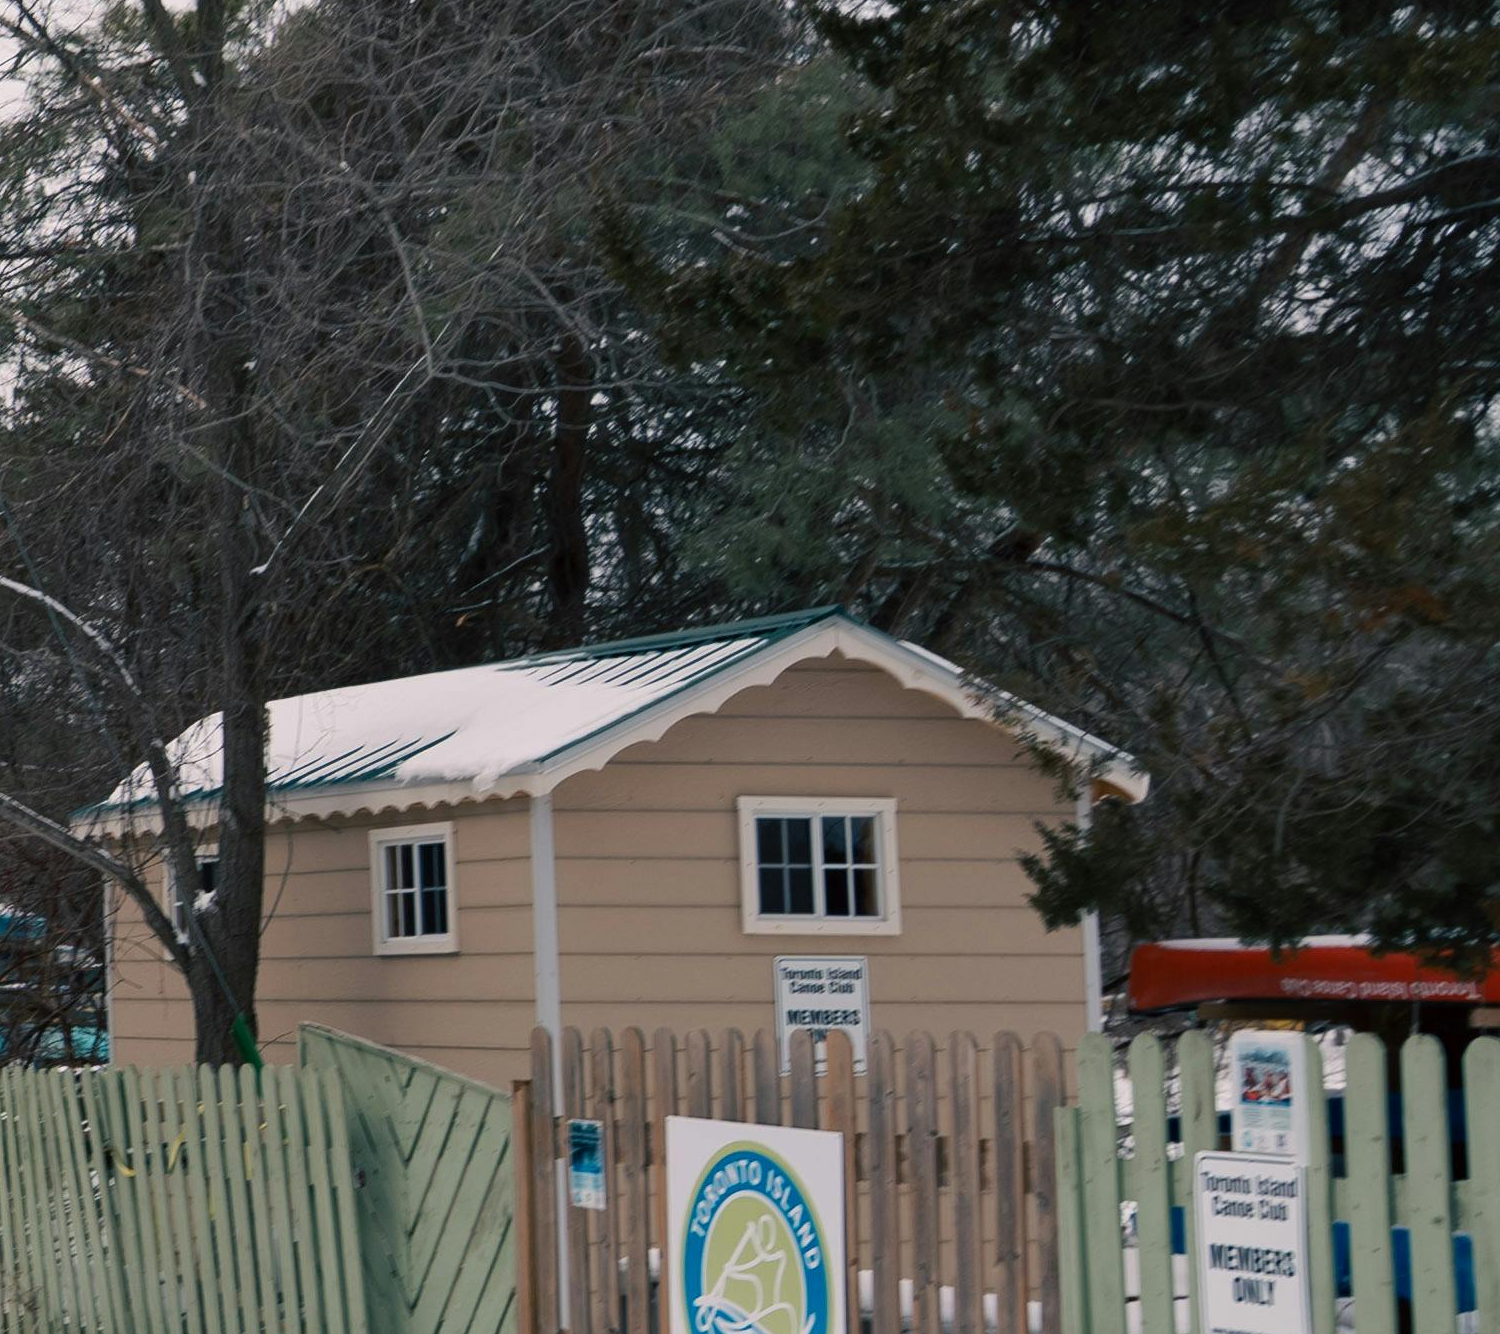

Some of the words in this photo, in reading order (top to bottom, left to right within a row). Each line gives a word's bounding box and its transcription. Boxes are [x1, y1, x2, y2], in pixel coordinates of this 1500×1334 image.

[780, 967, 823, 980] Toronto
[827, 967, 863, 980] Island
[789, 980, 825, 994] Canoe
[828, 980, 856, 994] Club
[786, 1009, 861, 1025] MEMBERS
[1201, 1171, 1251, 1193] Toronto
[1256, 1175, 1298, 1198] Island
[690, 1158, 762, 1238] TORONTO
[765, 1169, 821, 1270] ISLAND
[1212, 1195, 1253, 1219] Canoe
[1258, 1199, 1288, 1221] Club
[1209, 1243, 1295, 1277] MEMBERS
[1233, 1276, 1276, 1306] ONLY
